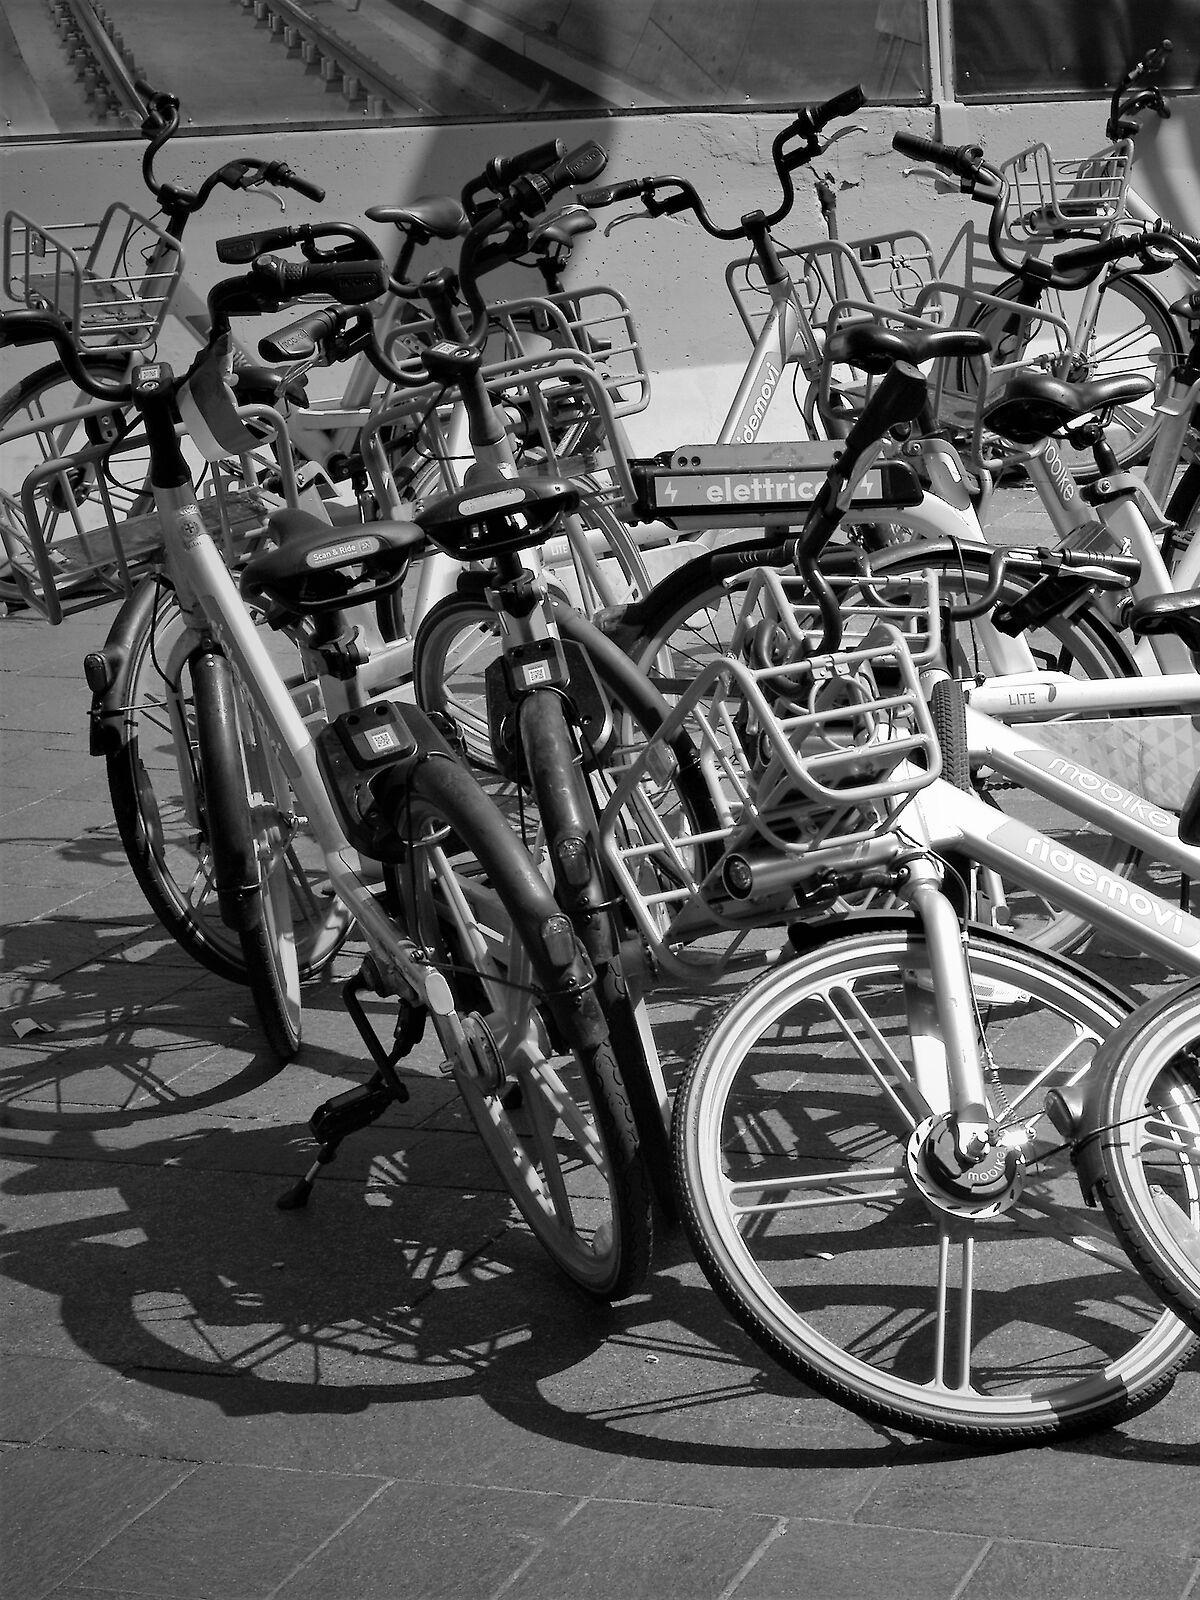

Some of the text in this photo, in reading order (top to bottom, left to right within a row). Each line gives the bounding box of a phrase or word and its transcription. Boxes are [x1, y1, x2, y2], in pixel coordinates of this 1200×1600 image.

[1044, 438, 1074, 501] obike
[313, 550, 332, 561] Scan
[339, 544, 356, 554] Ride
[550, 543, 569, 556] LITE
[1008, 692, 1036, 706] LITE
[1047, 758, 1172, 828] mobike
[1025, 837, 1184, 935] ridemovi
[967, 1151, 1006, 1182] mobike
